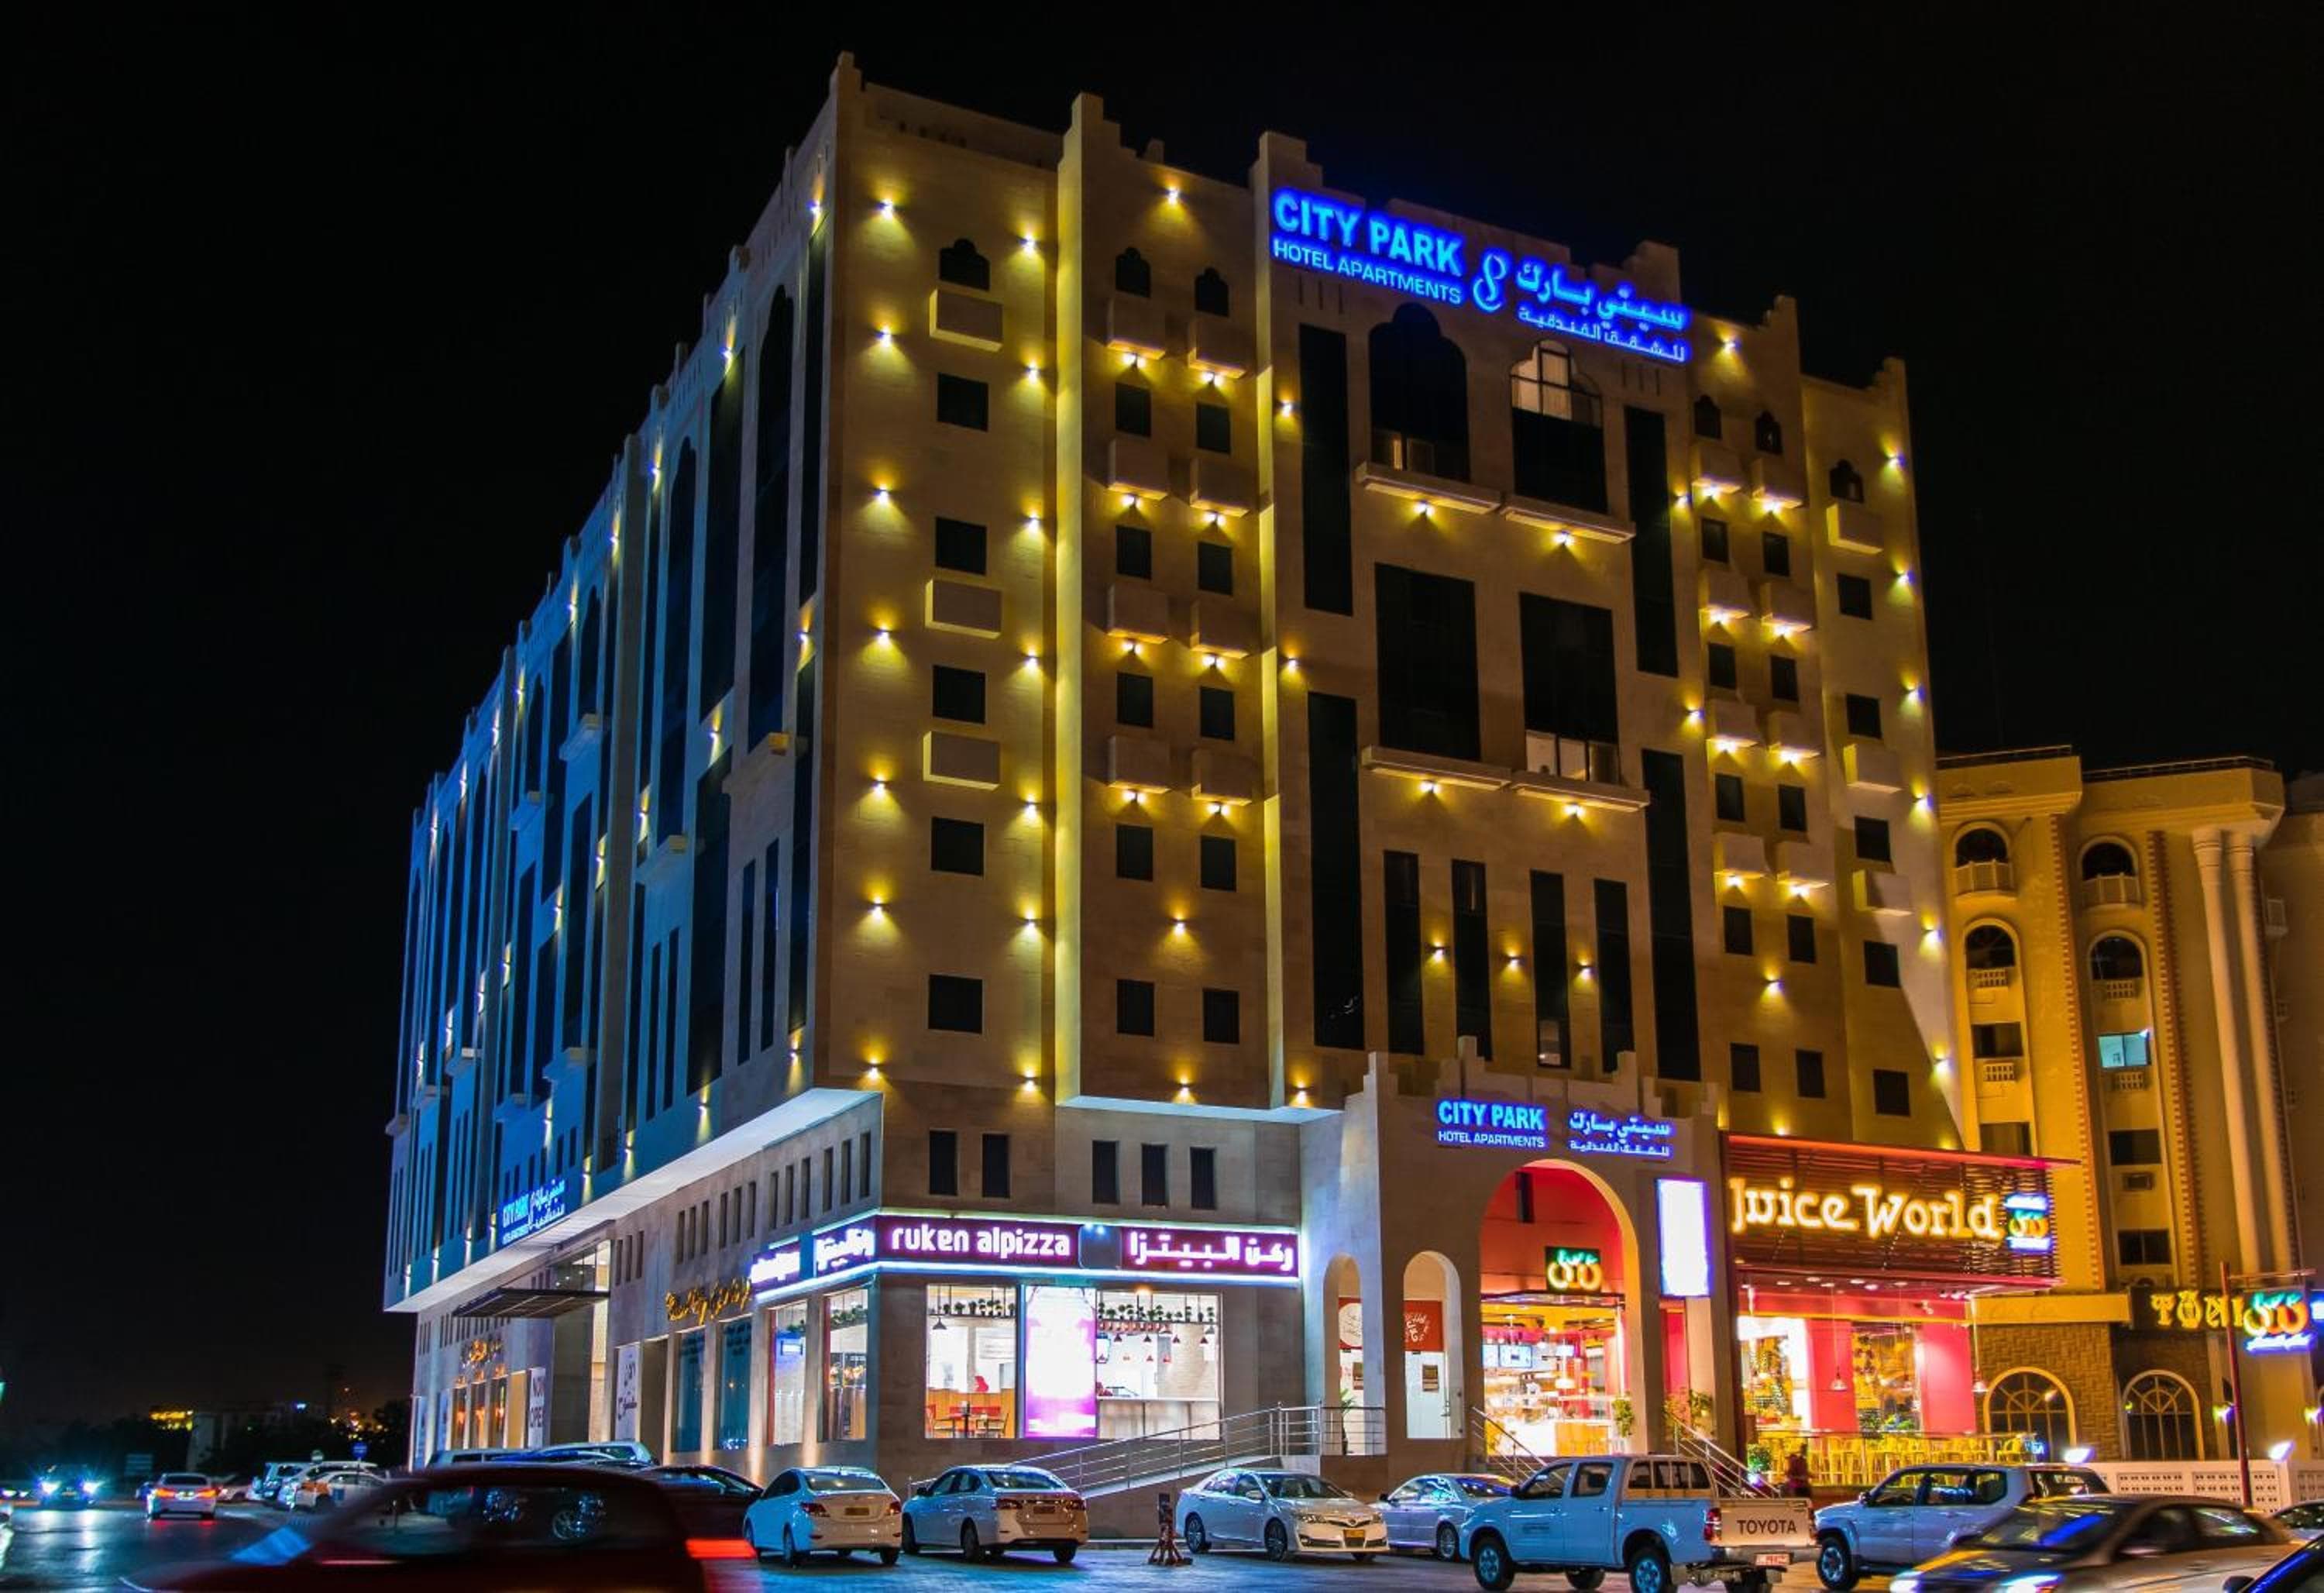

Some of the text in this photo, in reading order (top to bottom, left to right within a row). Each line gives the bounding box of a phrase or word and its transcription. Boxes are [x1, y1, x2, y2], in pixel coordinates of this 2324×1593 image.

[1274, 193, 1462, 277] CITY PARK
[1274, 239, 1462, 304] HOTEL APARTMENTS
[1516, 262, 1686, 332] سيتي بارك
[1518, 305, 1601, 341] الفندقية
[1439, 1101, 1544, 1130] CITY PARK
[1569, 1111, 1670, 1144] سيتي بارك
[1439, 1130, 1544, 1148] HOTEL APARTMENTS
[1728, 1176, 2005, 1239] Juice World
[892, 1224, 970, 1252] ruken
[977, 1228, 1071, 1258] alpizza
[1129, 1232, 1294, 1271] ركن البيتزا
[1737, 1519, 1796, 1534] TOYOTA
